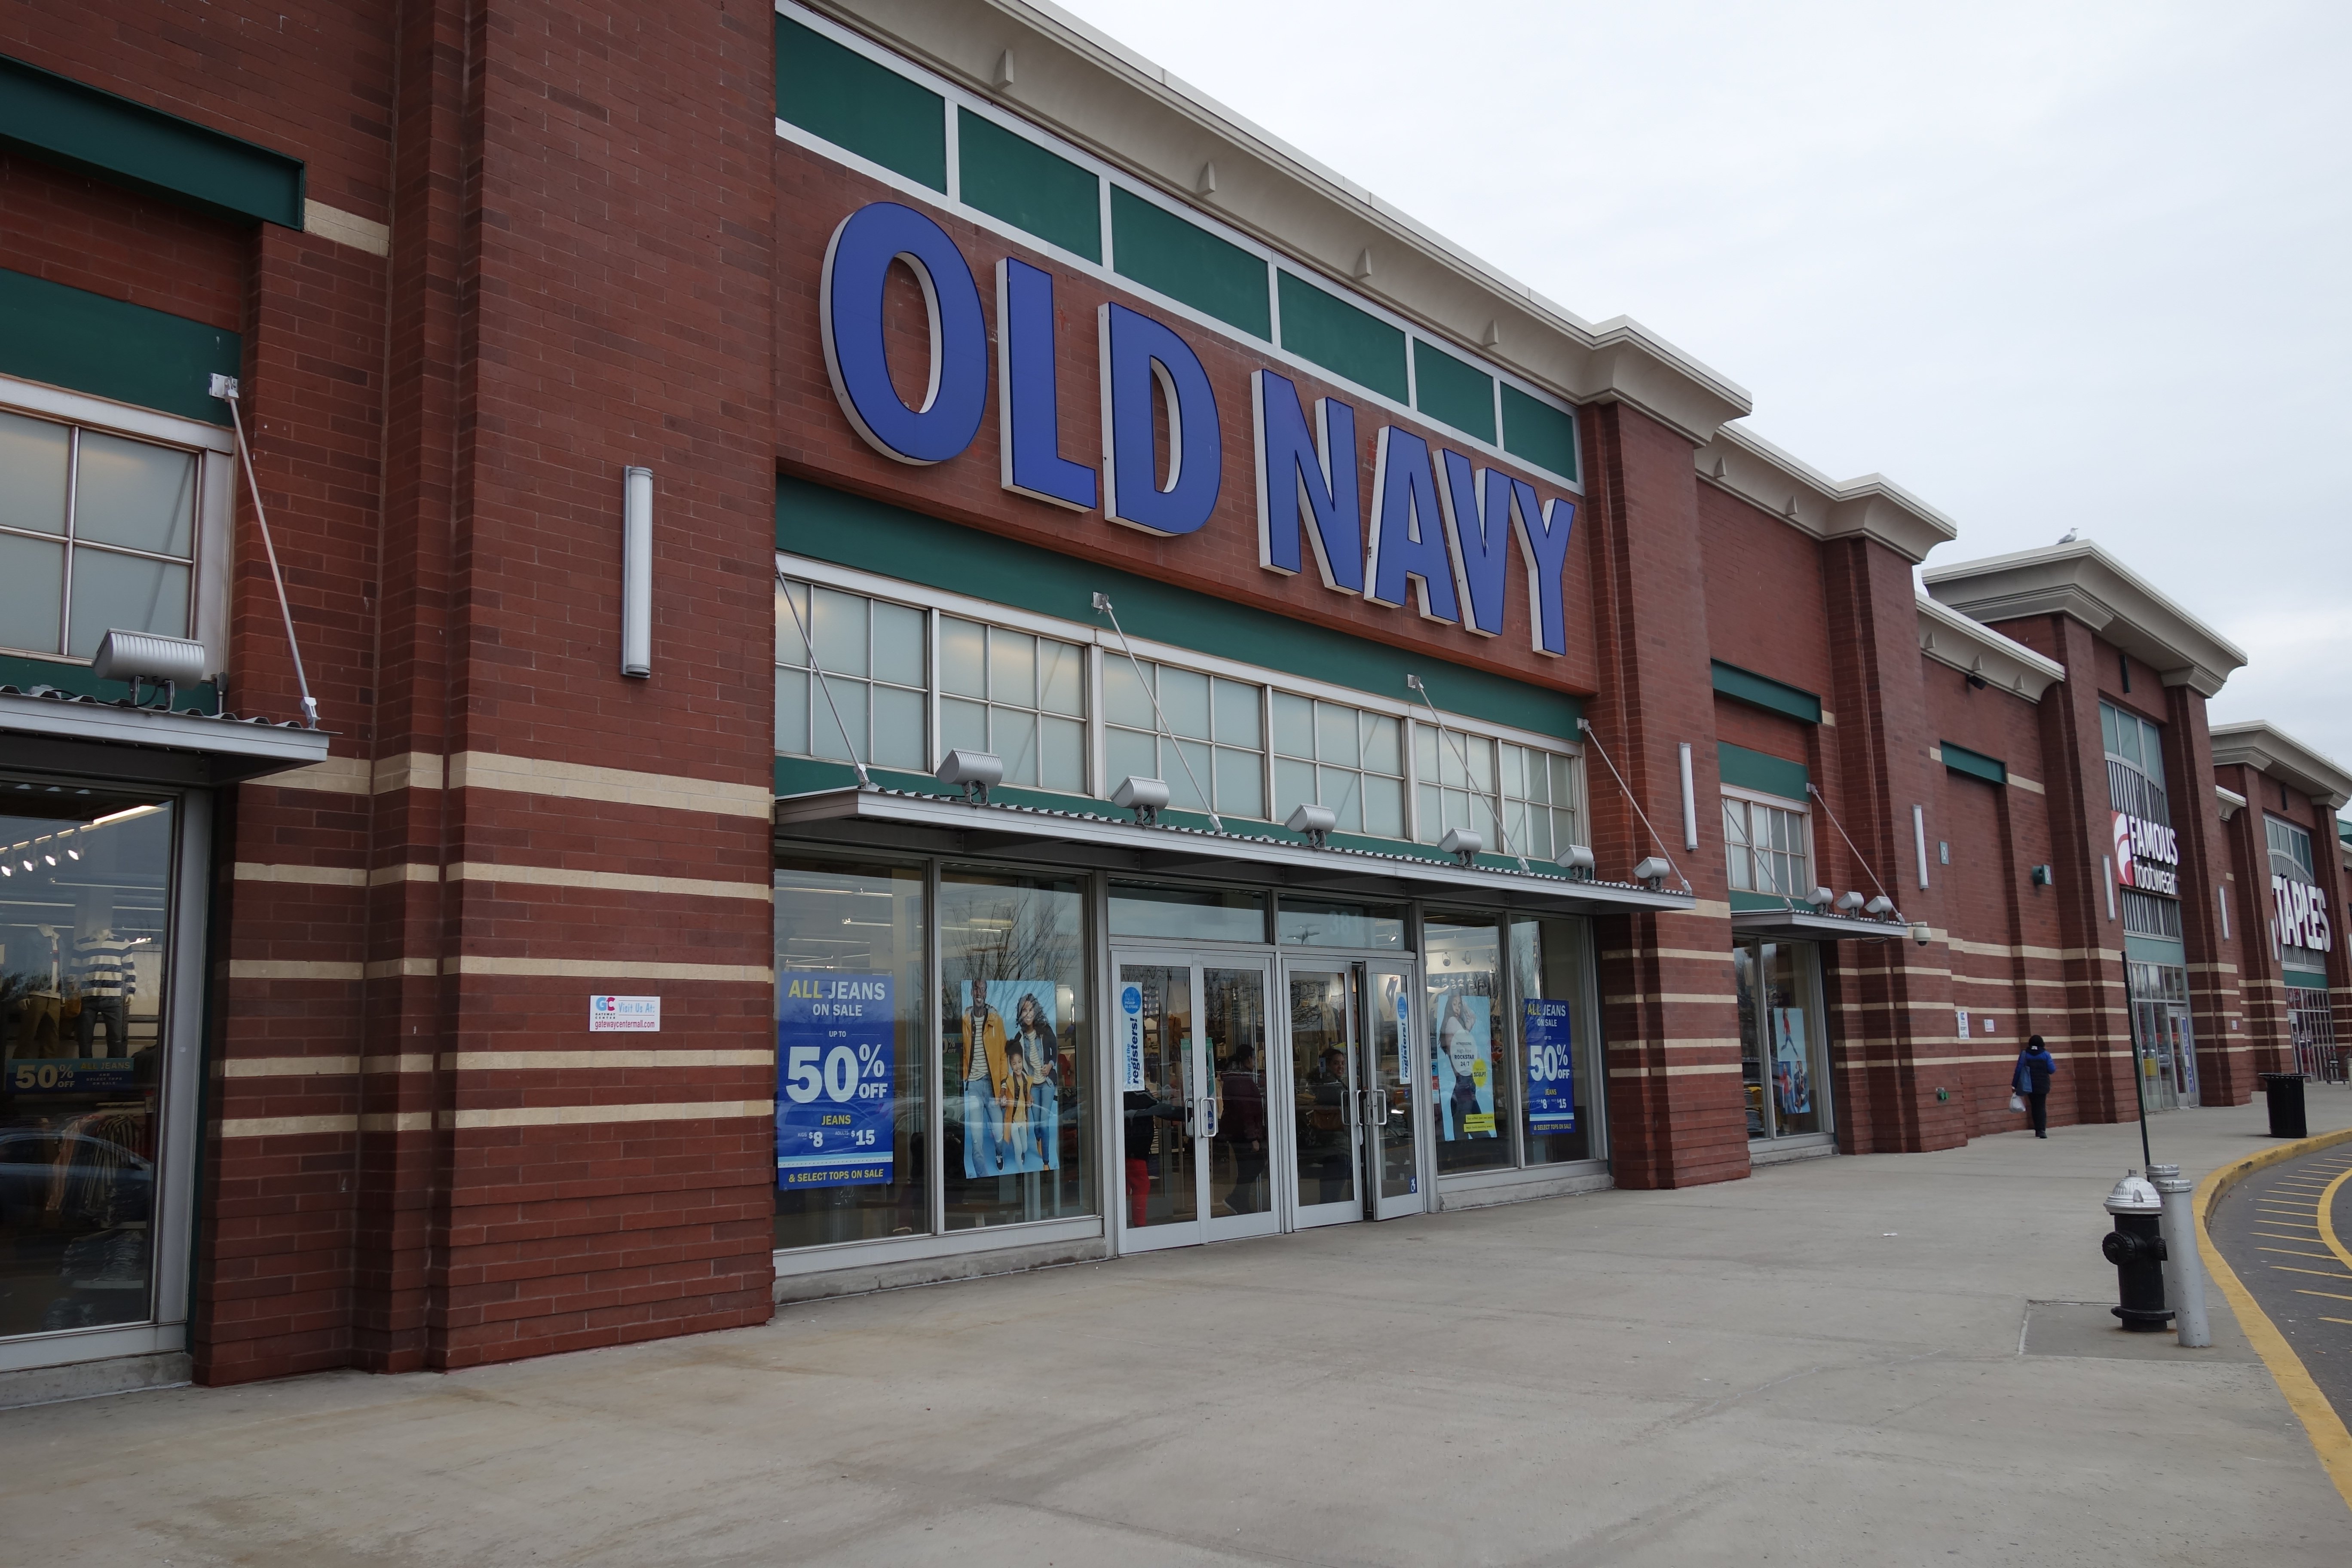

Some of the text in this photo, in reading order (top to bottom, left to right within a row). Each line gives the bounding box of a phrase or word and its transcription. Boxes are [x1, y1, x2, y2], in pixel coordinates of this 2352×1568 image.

[820, 202, 1575, 657] OLD NAVY
[2128, 815, 2178, 866] FAMOUS
[2133, 856, 2177, 895] footwear
[2271, 875, 2331, 952] TAPLES
[788, 980, 885, 1000] ALL JEANS
[596, 997, 616, 1011] GC
[619, 1002, 633, 1013] Visit
[635, 1003, 643, 1013] Us
[813, 1004, 862, 1016] ON SALE
[1528, 1004, 1566, 1017] ALL JEANS
[595, 1020, 655, 1029] gatewaycentermall.com
[1545, 1019, 1557, 1027] SALE
[1130, 1017, 1140, 1084] registers!
[1530, 1044, 1570, 1081] 50% OFF
[15, 1064, 74, 1089] 50%
[786, 1044, 888, 1103] 50% OFF
[821, 1115, 851, 1125] JEANS
[808, 1131, 823, 1147] $8
[851, 1130, 875, 1145] $15
[789, 1169, 884, 1182] & SELECT TOPS ON SALE
